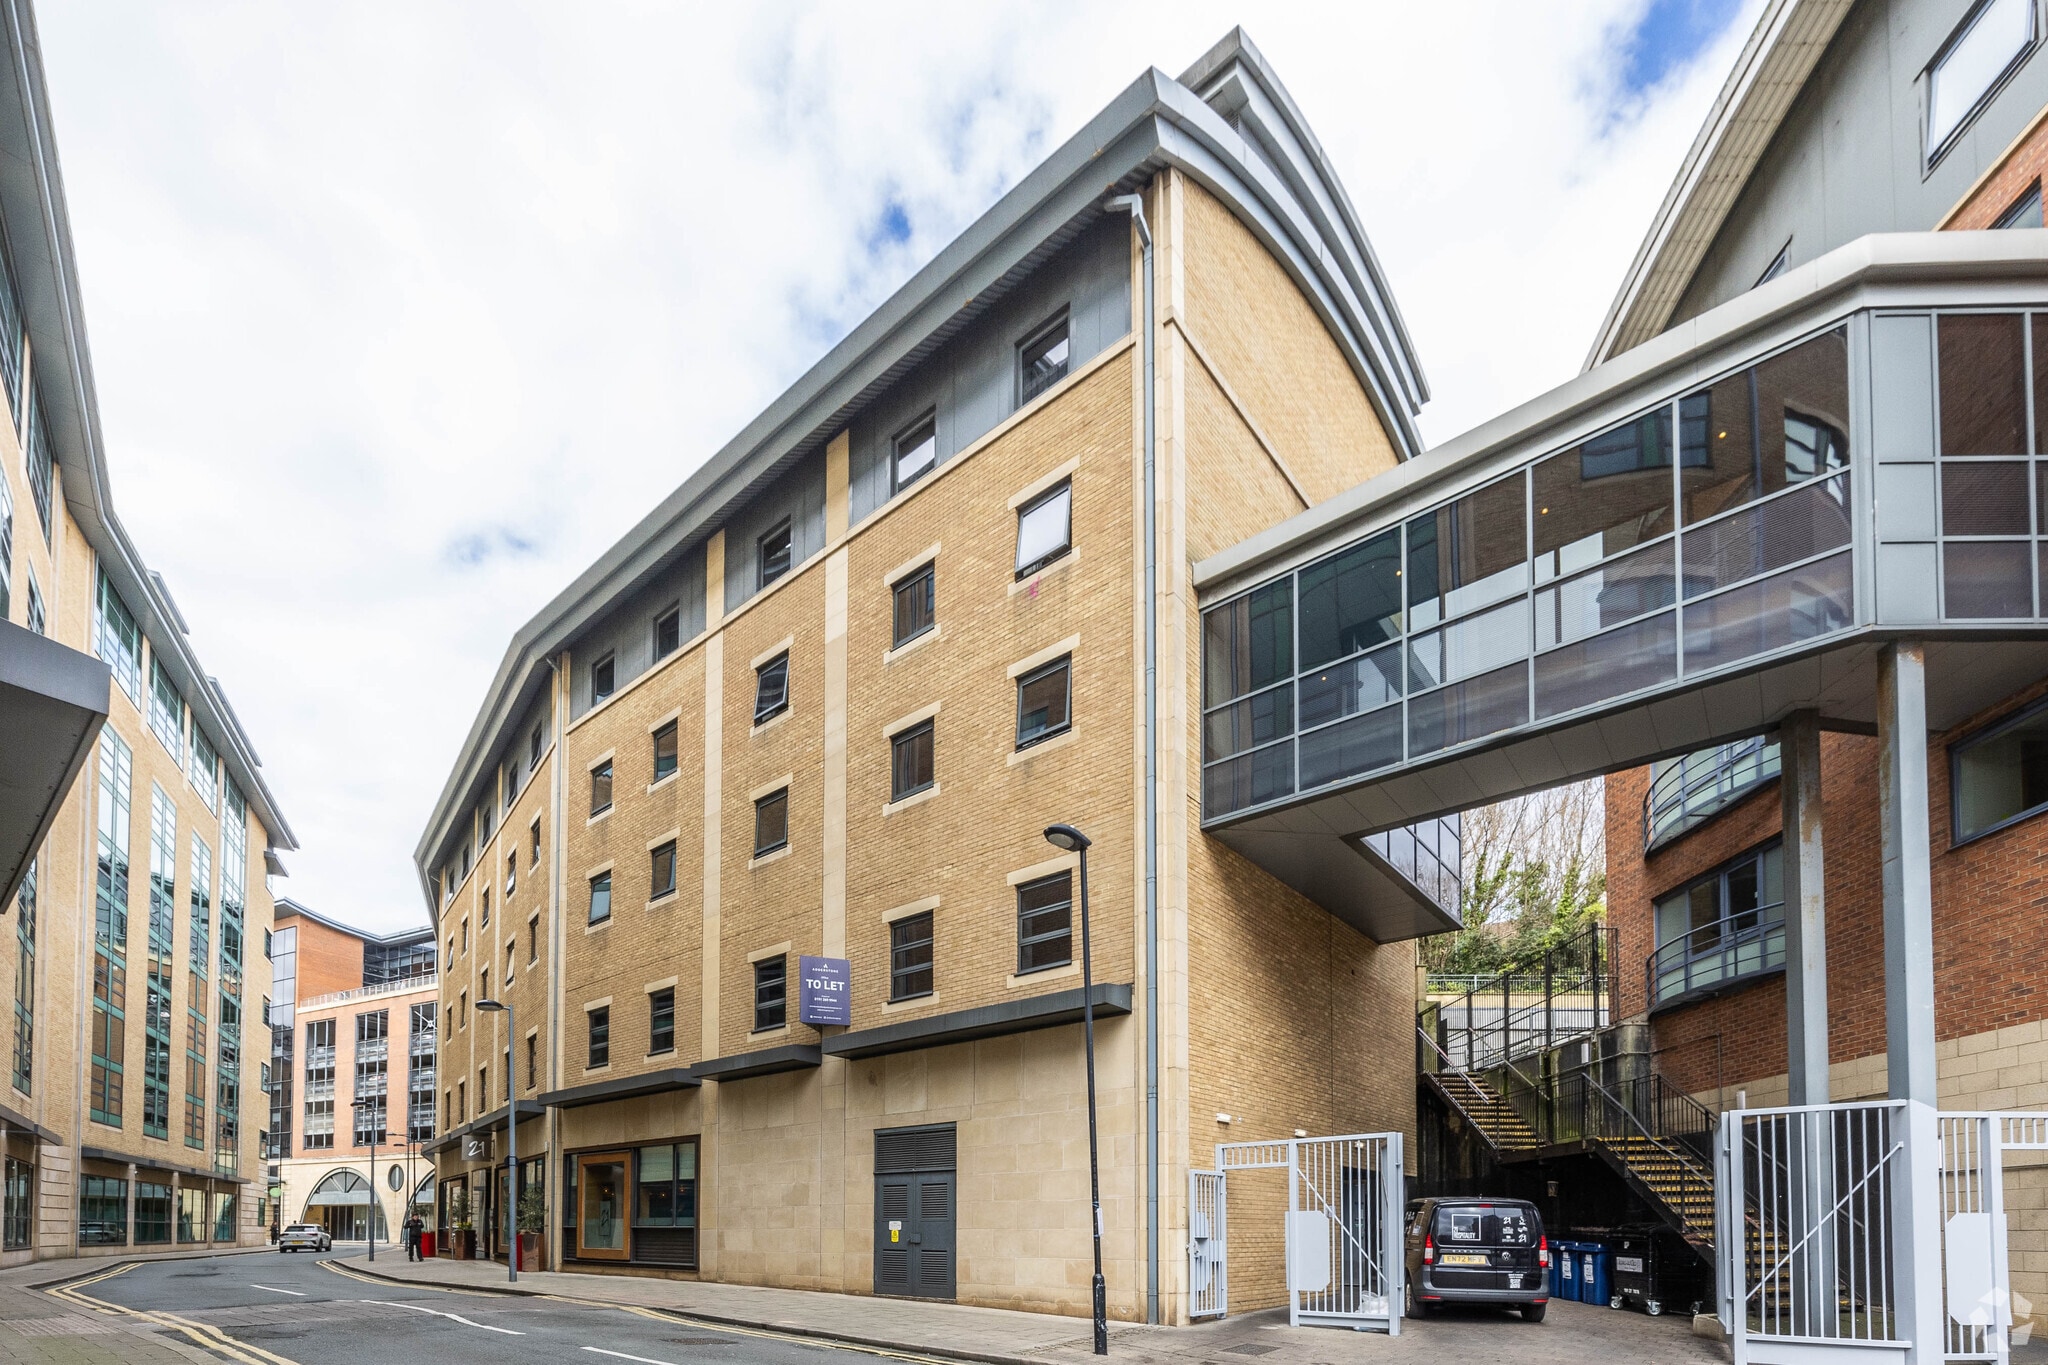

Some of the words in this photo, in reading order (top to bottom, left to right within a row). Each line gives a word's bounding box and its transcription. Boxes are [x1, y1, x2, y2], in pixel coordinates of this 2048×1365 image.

[806, 978, 822, 990] TO
[824, 980, 844, 991] LET
[467, 1140, 485, 1157] 21
[1503, 1216, 1512, 1225] 21
[1518, 1233, 1527, 1243] 21
